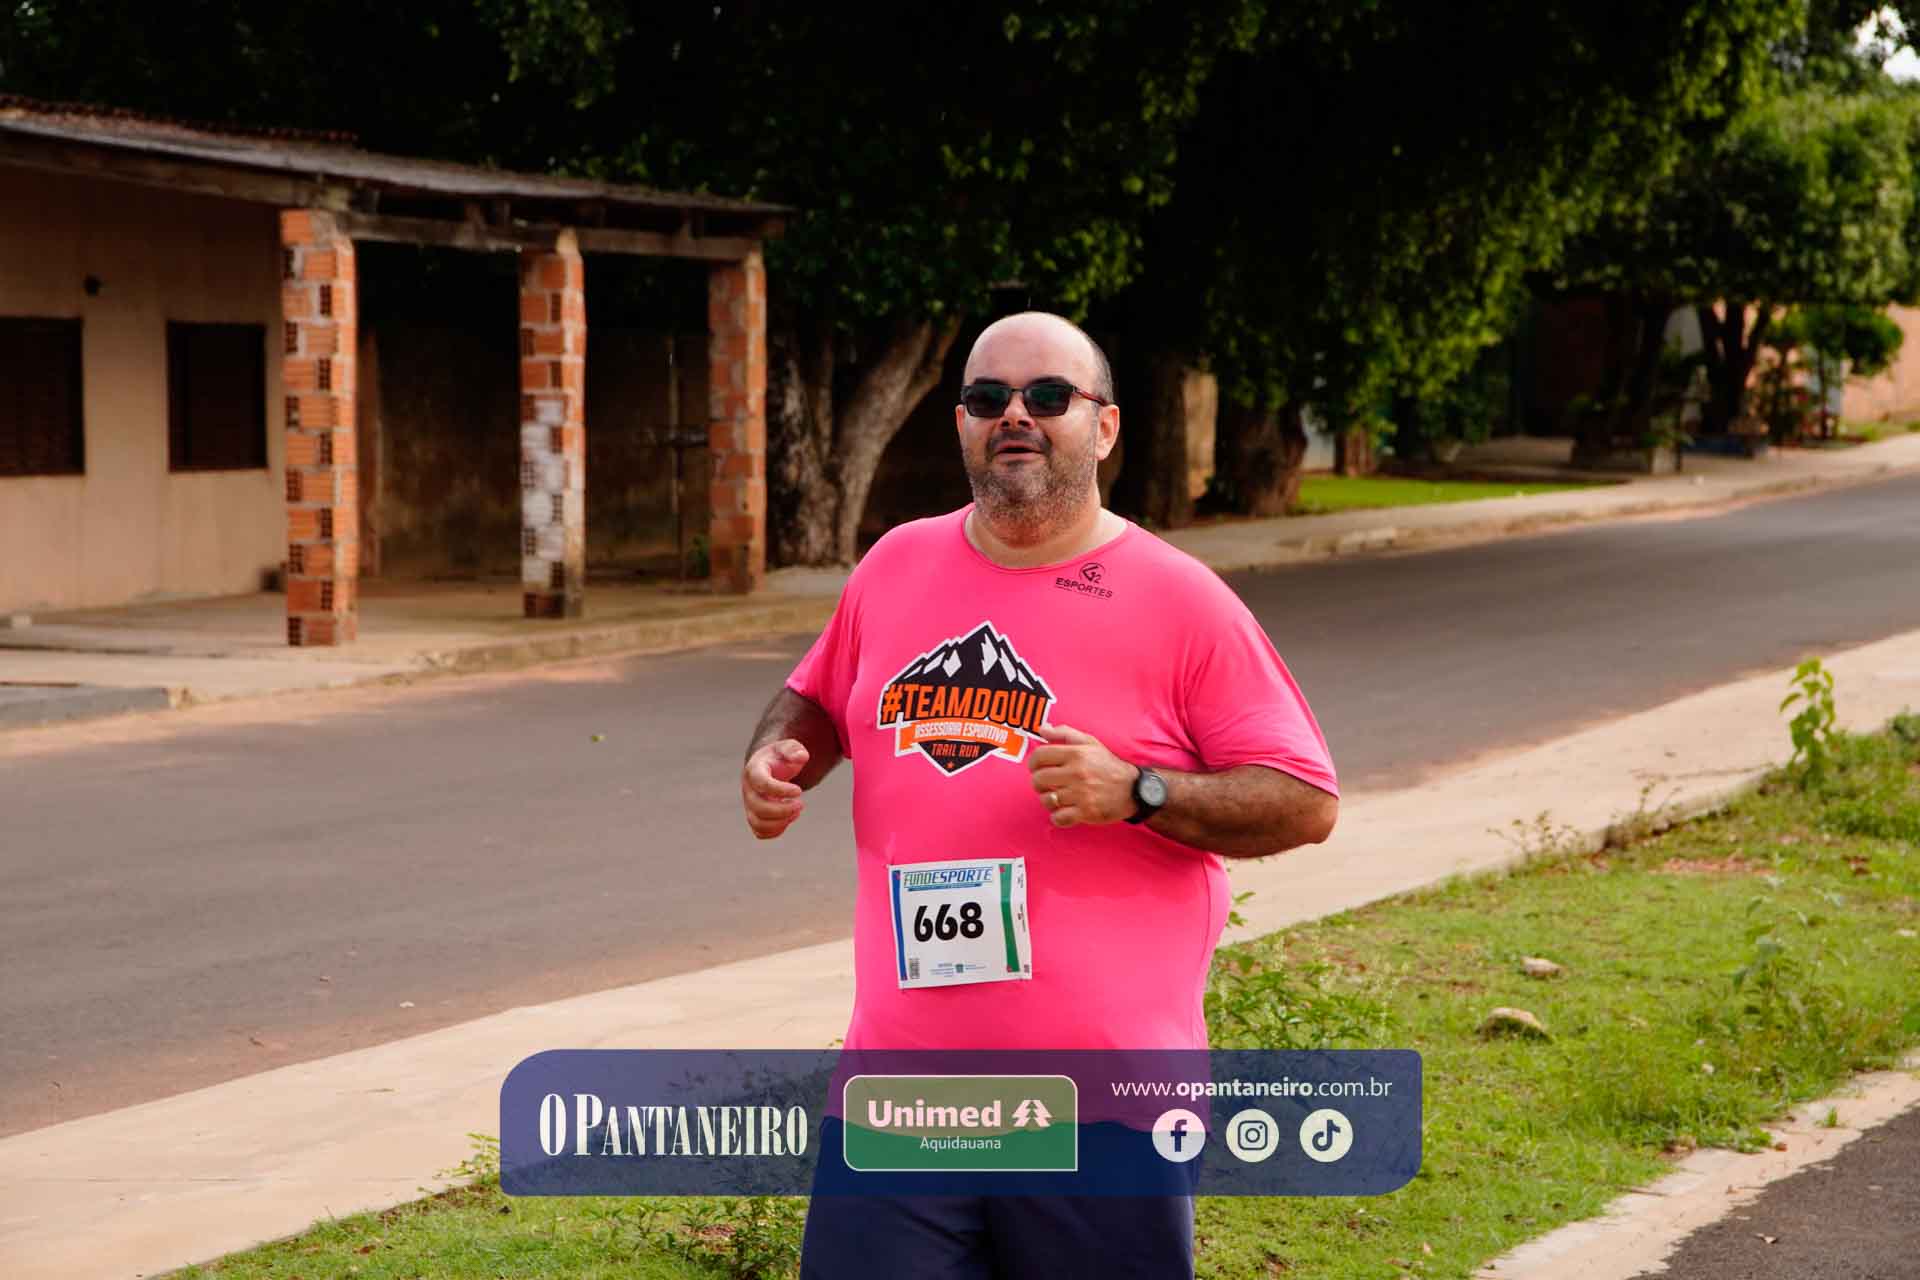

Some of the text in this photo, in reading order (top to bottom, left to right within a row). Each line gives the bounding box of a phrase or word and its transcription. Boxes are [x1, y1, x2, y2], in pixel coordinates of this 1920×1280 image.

[1055, 577, 1113, 598] ESPORTES
[962, 722, 1009, 744] ESPORTIVA
[931, 743, 980, 758] TRAIL RUN
[904, 868, 993, 886] FUNDESPORTE
[914, 901, 984, 942] 668
